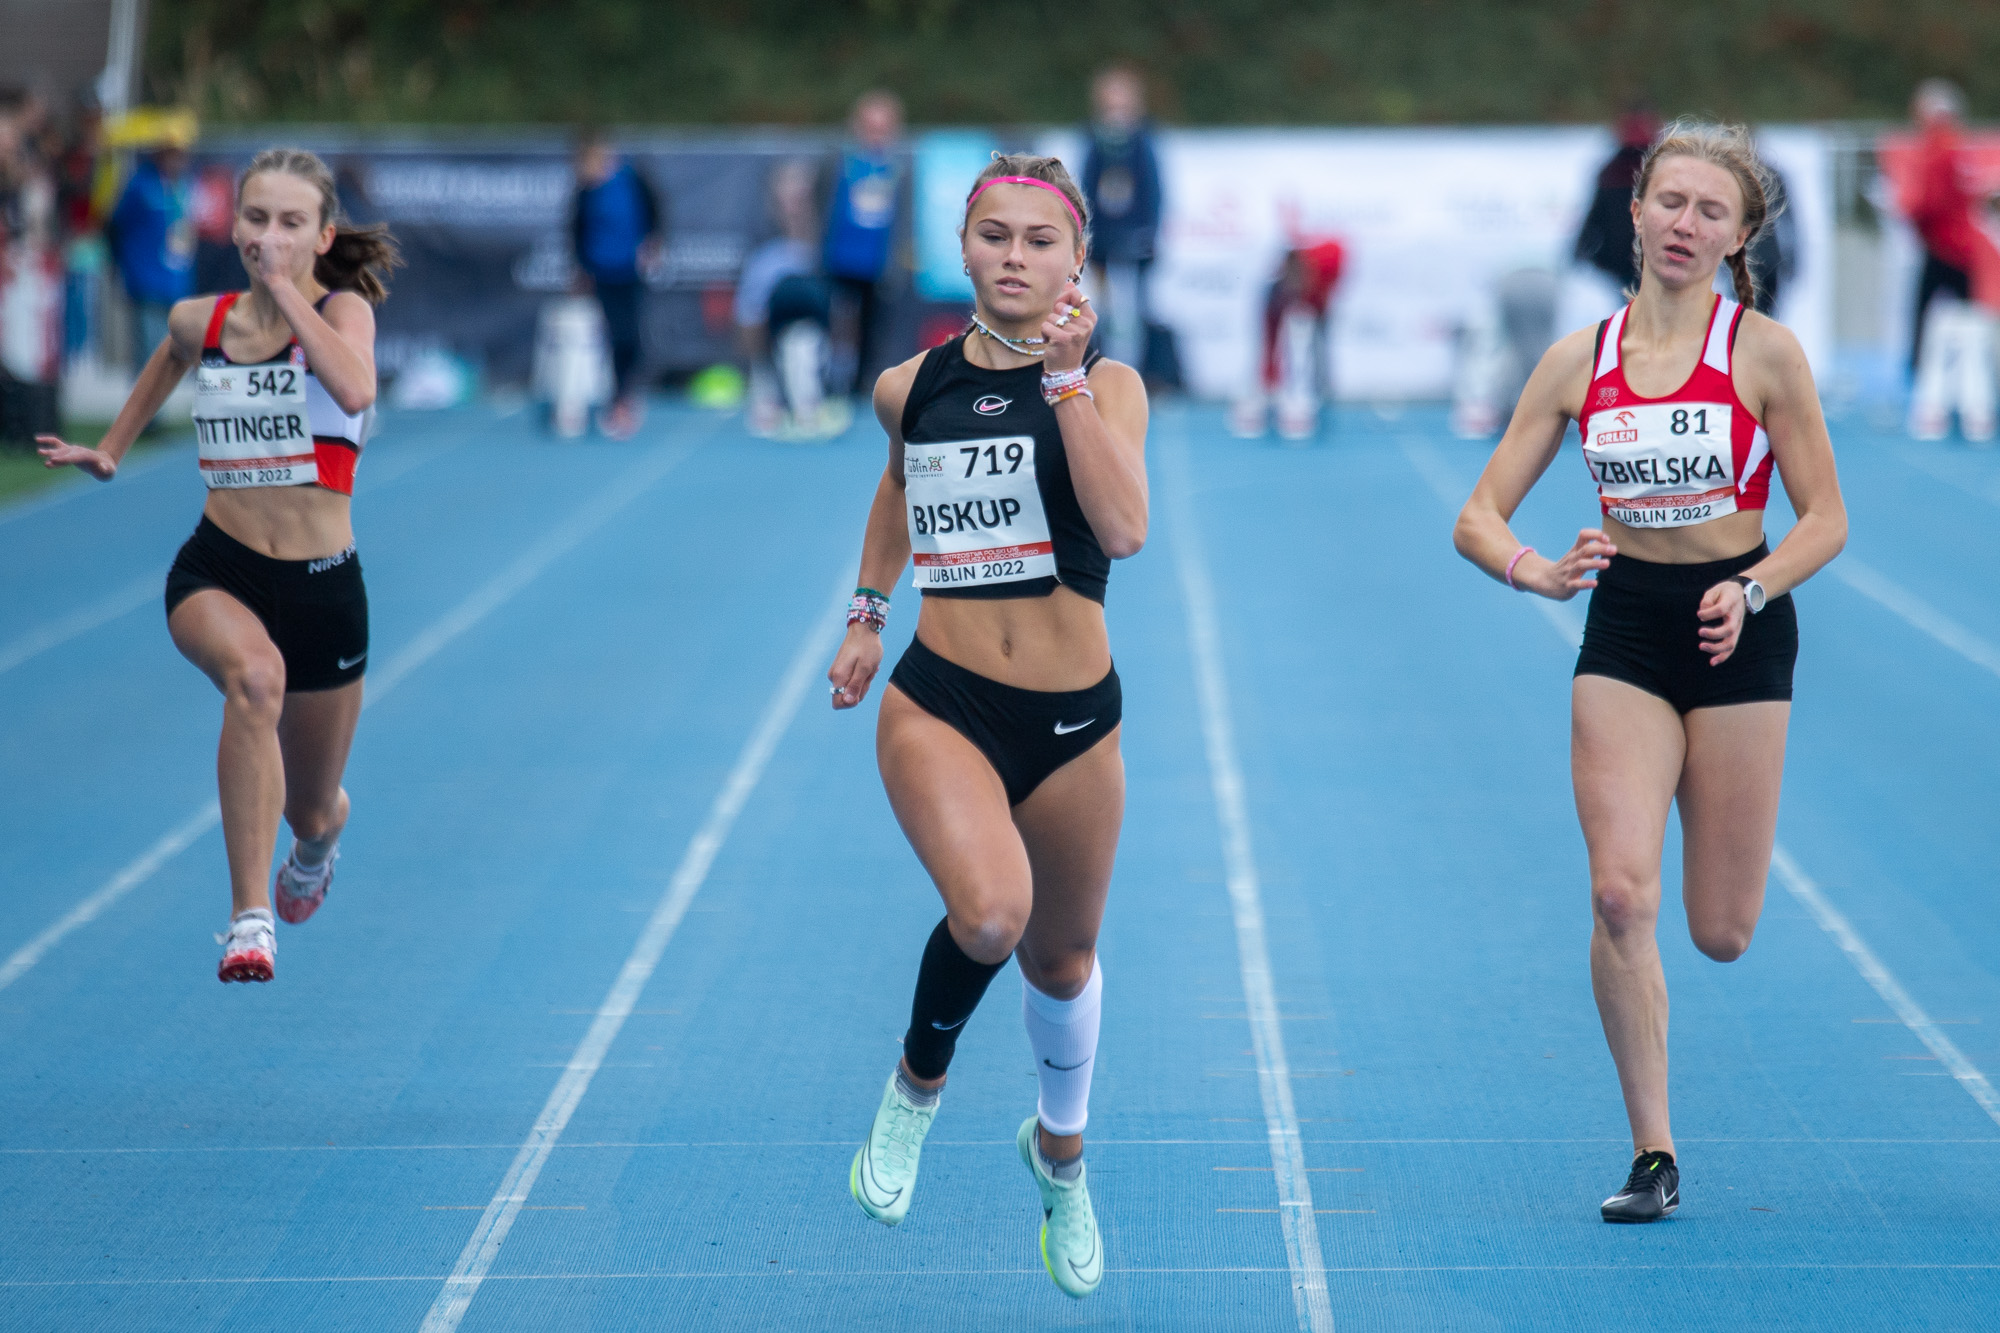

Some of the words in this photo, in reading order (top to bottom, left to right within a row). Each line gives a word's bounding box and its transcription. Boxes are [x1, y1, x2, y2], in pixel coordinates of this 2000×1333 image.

[247, 369, 297, 397] 542
[194, 414, 305, 444] TITTINGER
[1670, 408, 1710, 436] 81
[1598, 431, 1636, 444] ORLEN
[959, 442, 1024, 478] 719
[1593, 455, 1727, 485] ZBIELSKA
[211, 471, 253, 485] LUBLIN
[258, 468, 293, 482] 2022
[913, 498, 1021, 535] BISKUP
[1617, 509, 1666, 523] LUBLIN
[1672, 504, 1712, 522] 2022
[309, 553, 345, 574] NIKE
[929, 566, 976, 583] LUBLIN
[981, 560, 1025, 579] 2022
